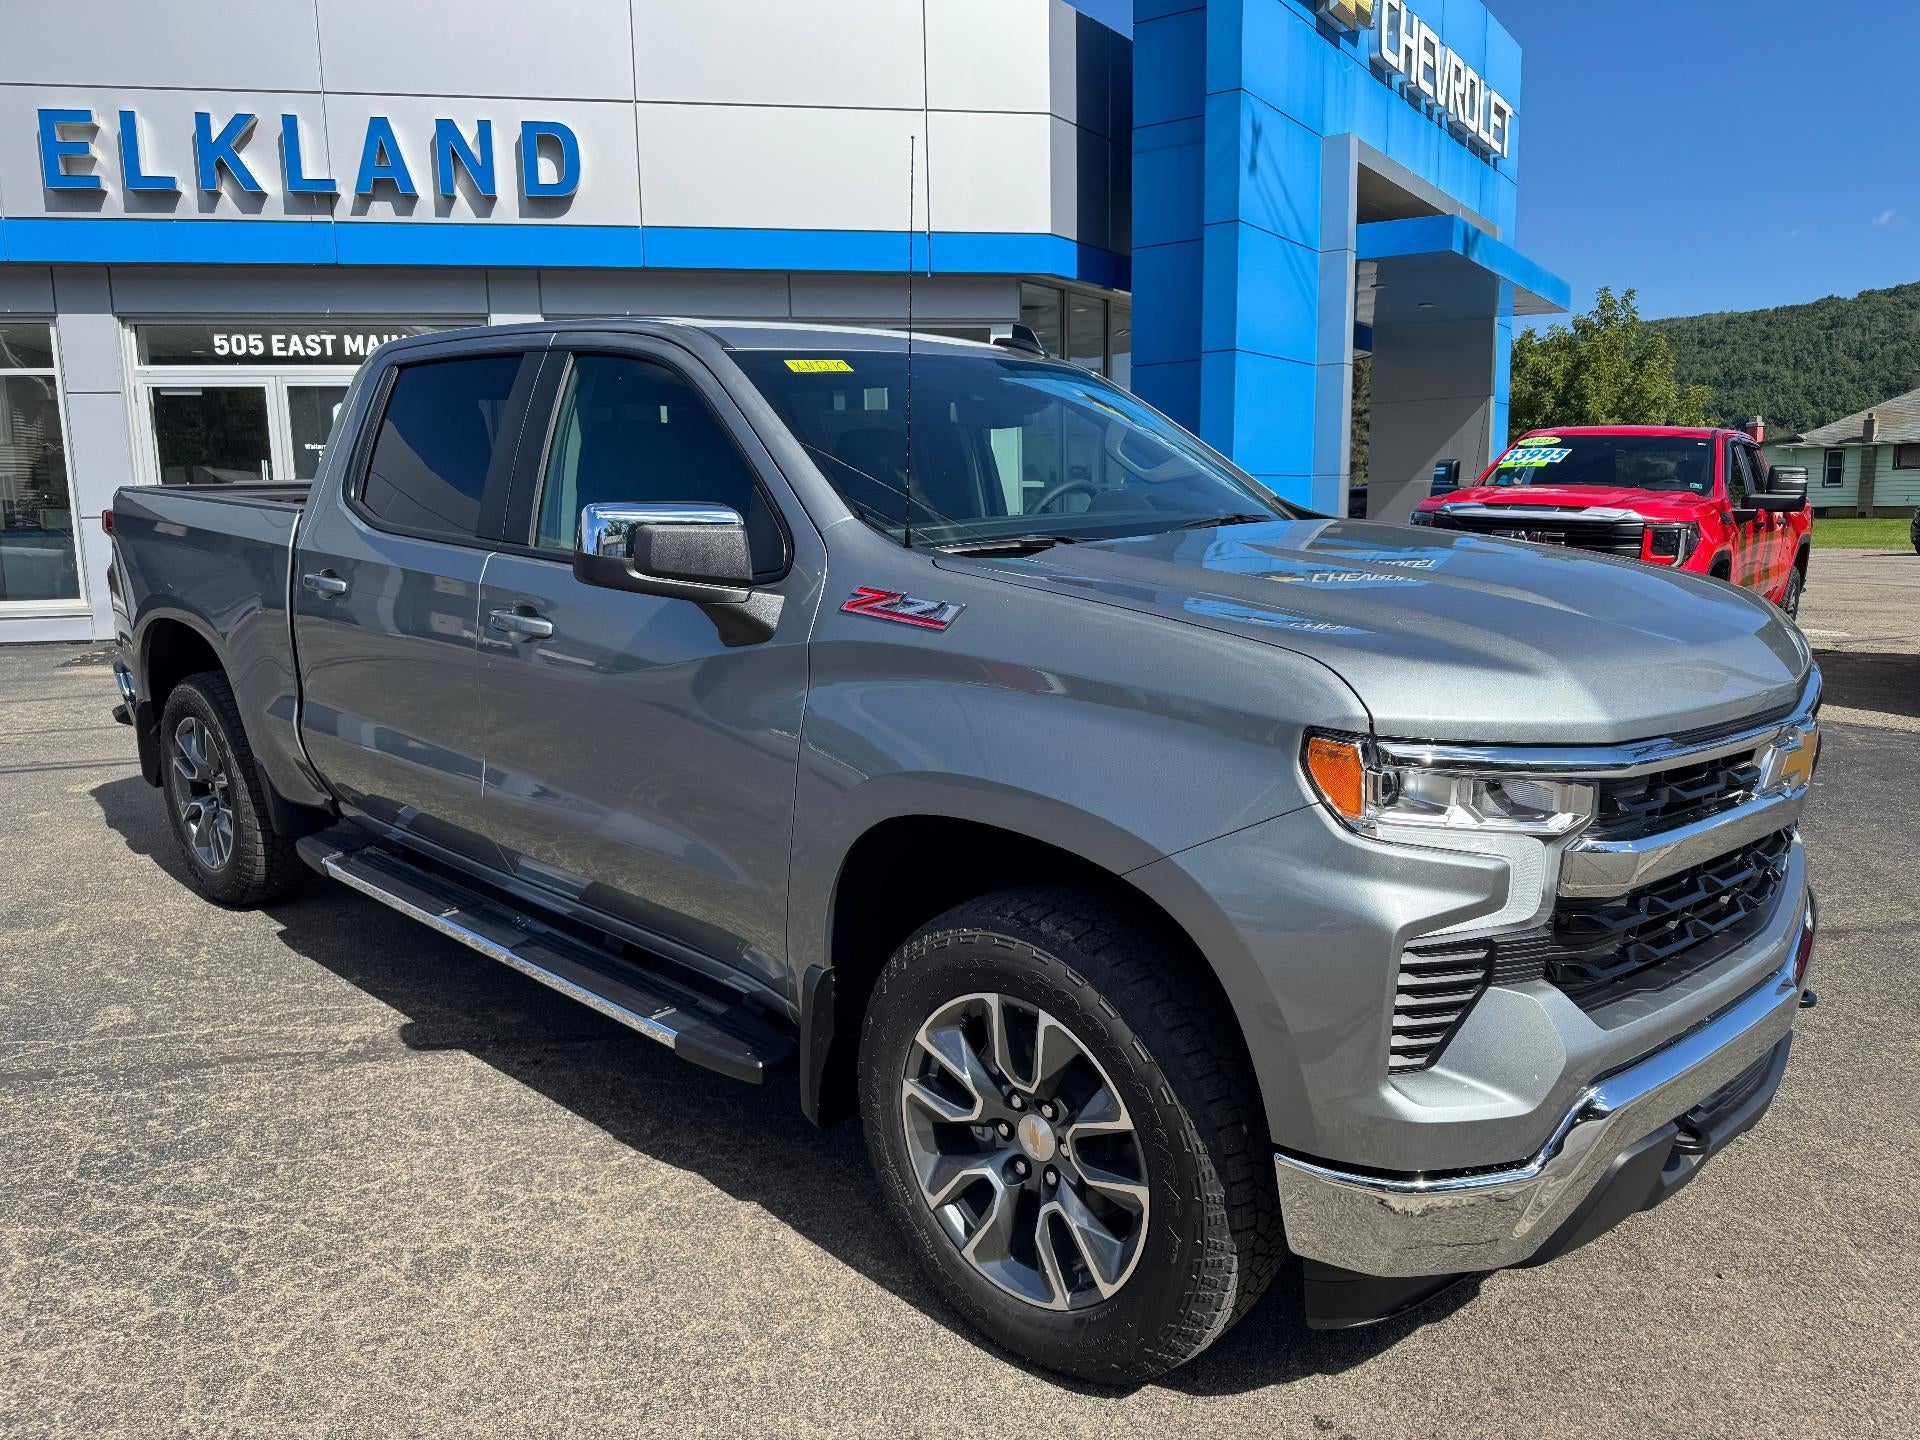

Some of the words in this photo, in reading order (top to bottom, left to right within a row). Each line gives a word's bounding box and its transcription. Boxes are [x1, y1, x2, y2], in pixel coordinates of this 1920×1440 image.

[1379, 0, 1514, 160] CHEVROLET
[37, 109, 582, 199] ELKLAND
[213, 333, 265, 356] 505
[271, 334, 336, 356] EAST
[343, 334, 407, 356] MA
[1502, 449, 1569, 463] 33995
[840, 584, 967, 632] Z71
